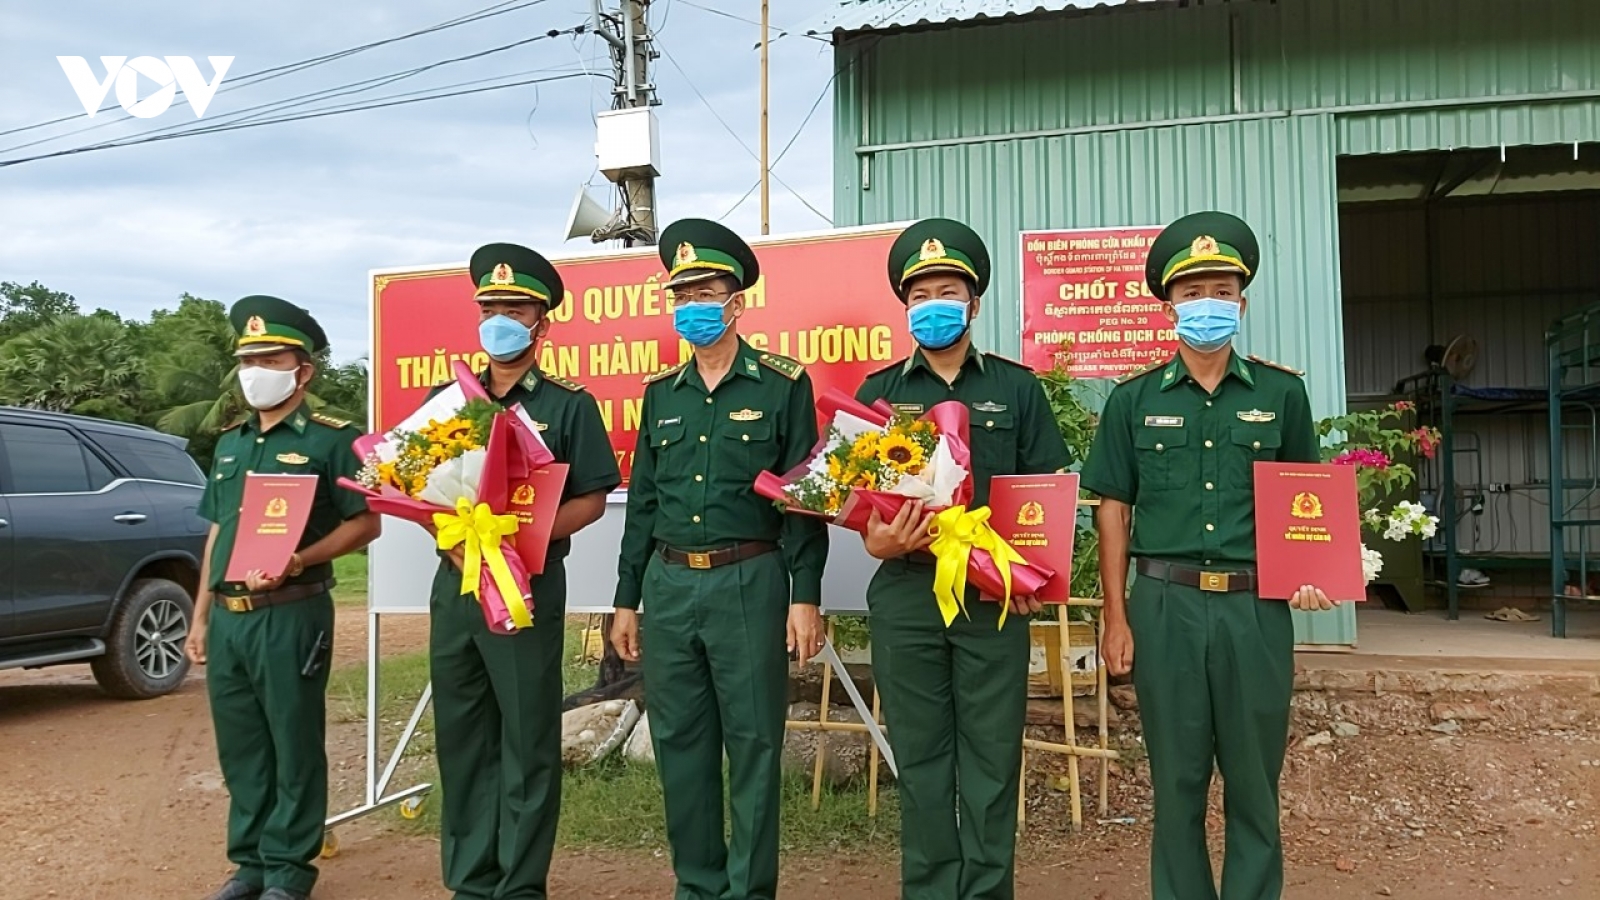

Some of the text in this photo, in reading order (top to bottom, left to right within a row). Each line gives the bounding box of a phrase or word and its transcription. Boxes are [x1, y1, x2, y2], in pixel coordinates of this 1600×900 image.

[1069, 236, 1101, 250] PHÒNG
[1059, 277, 1119, 300] CHỐT
[1100, 316, 1148, 325] PEG No. 20
[1034, 330, 1075, 345] PHÒNG
[1079, 328, 1121, 343] CHỐNG
[1124, 329, 1154, 345] DỊCH
[1067, 364, 1097, 372] DISEASE
